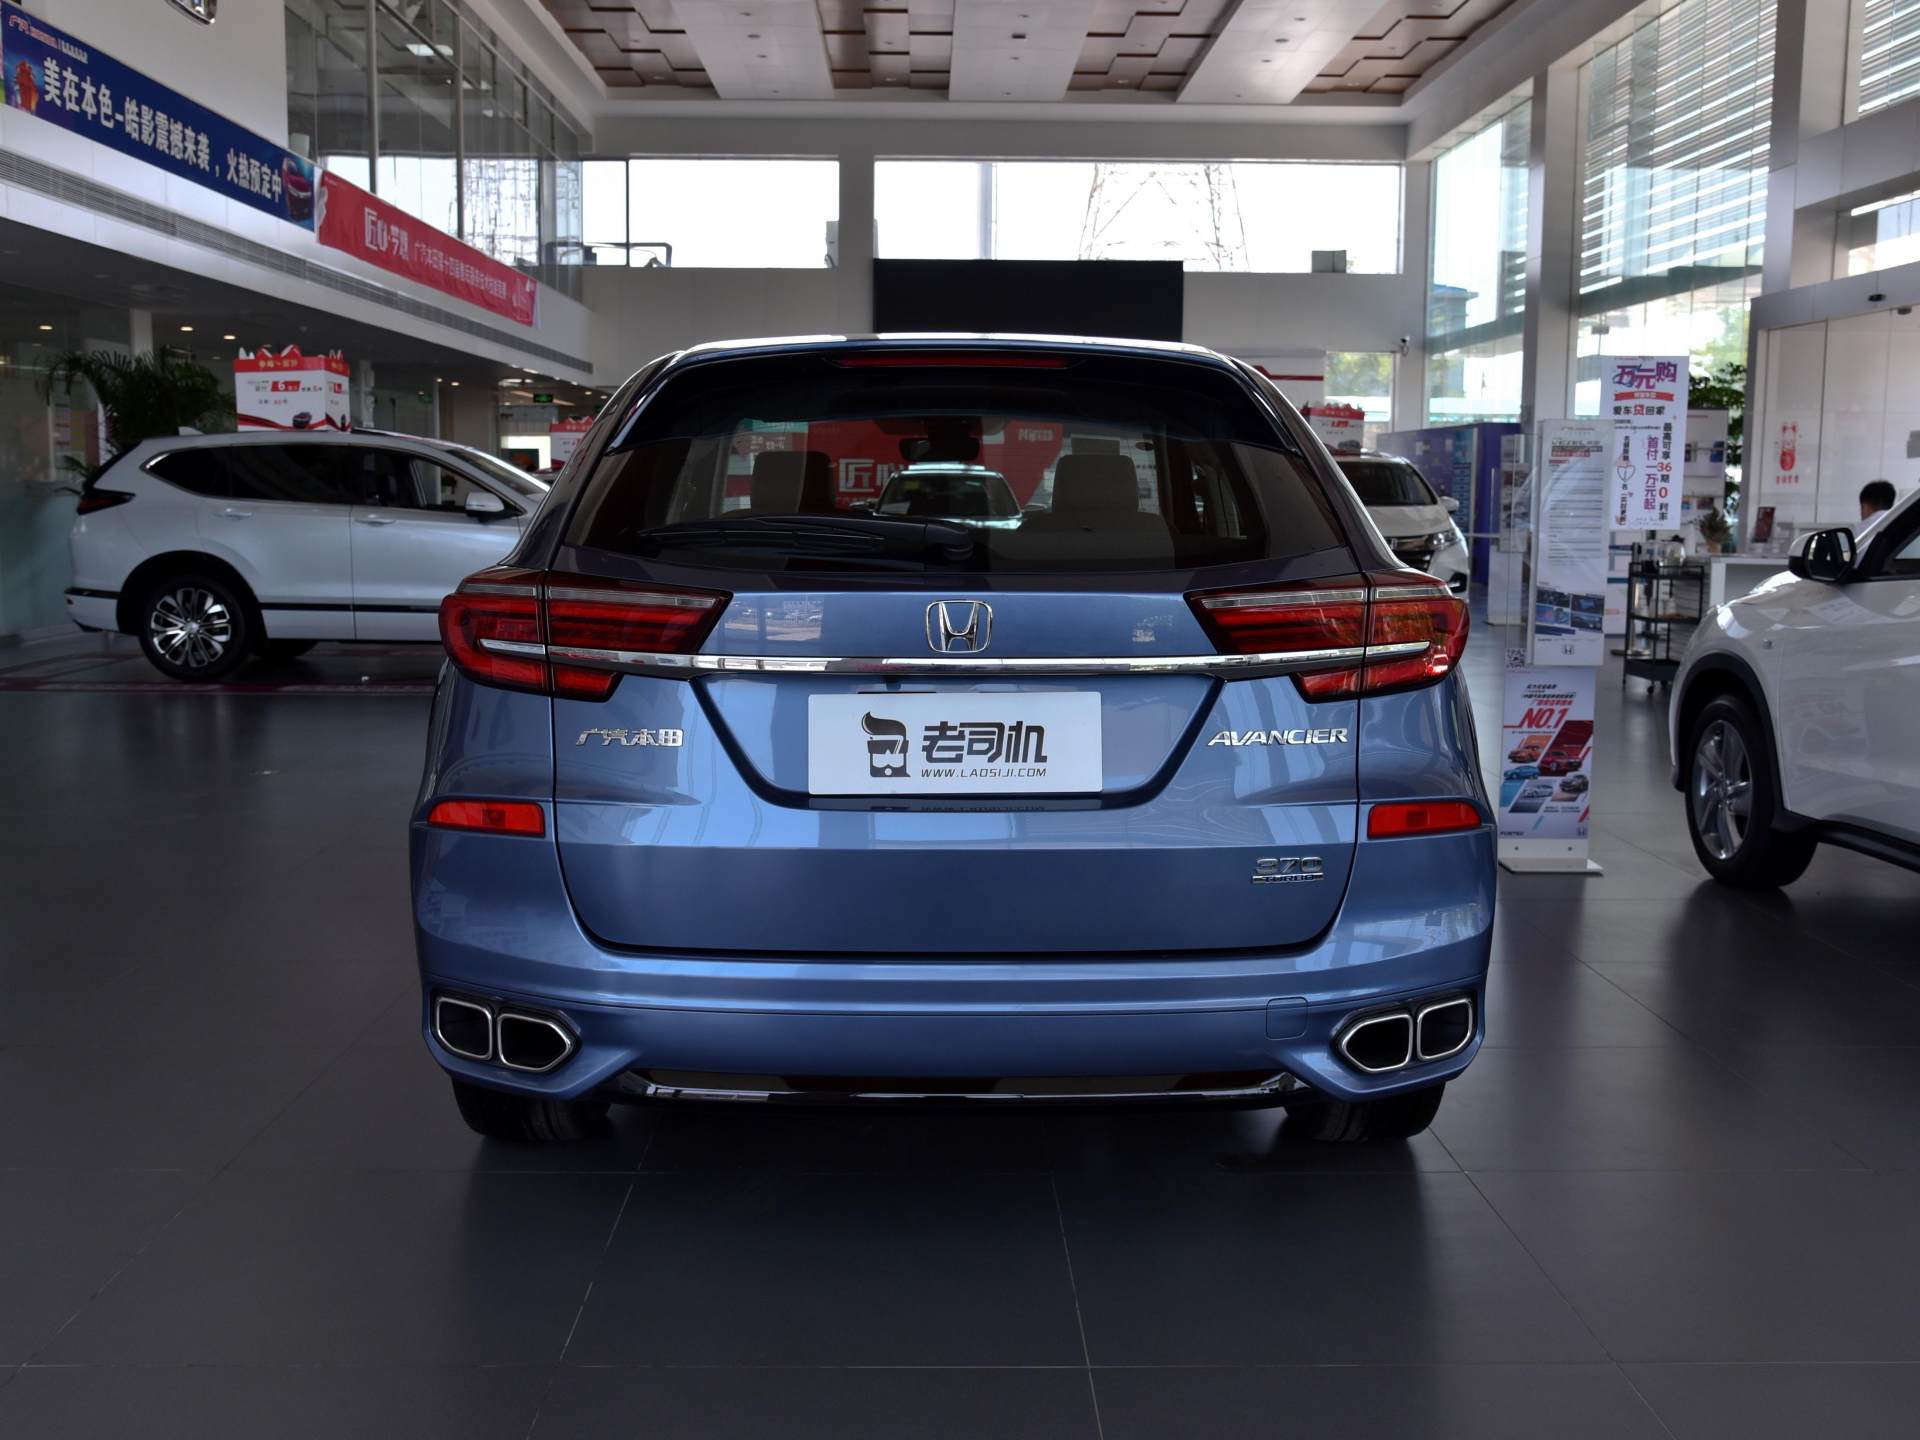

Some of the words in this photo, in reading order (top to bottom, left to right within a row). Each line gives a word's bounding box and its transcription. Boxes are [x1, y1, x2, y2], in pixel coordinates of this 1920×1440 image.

[575, 728, 684, 747] 广汽本田
[921, 720, 1048, 764] 老司机
[1207, 727, 1349, 747] AVANCIER
[920, 768, 1047, 778] WWW.LAOSIJI.COM
[1255, 856, 1324, 874] 370
